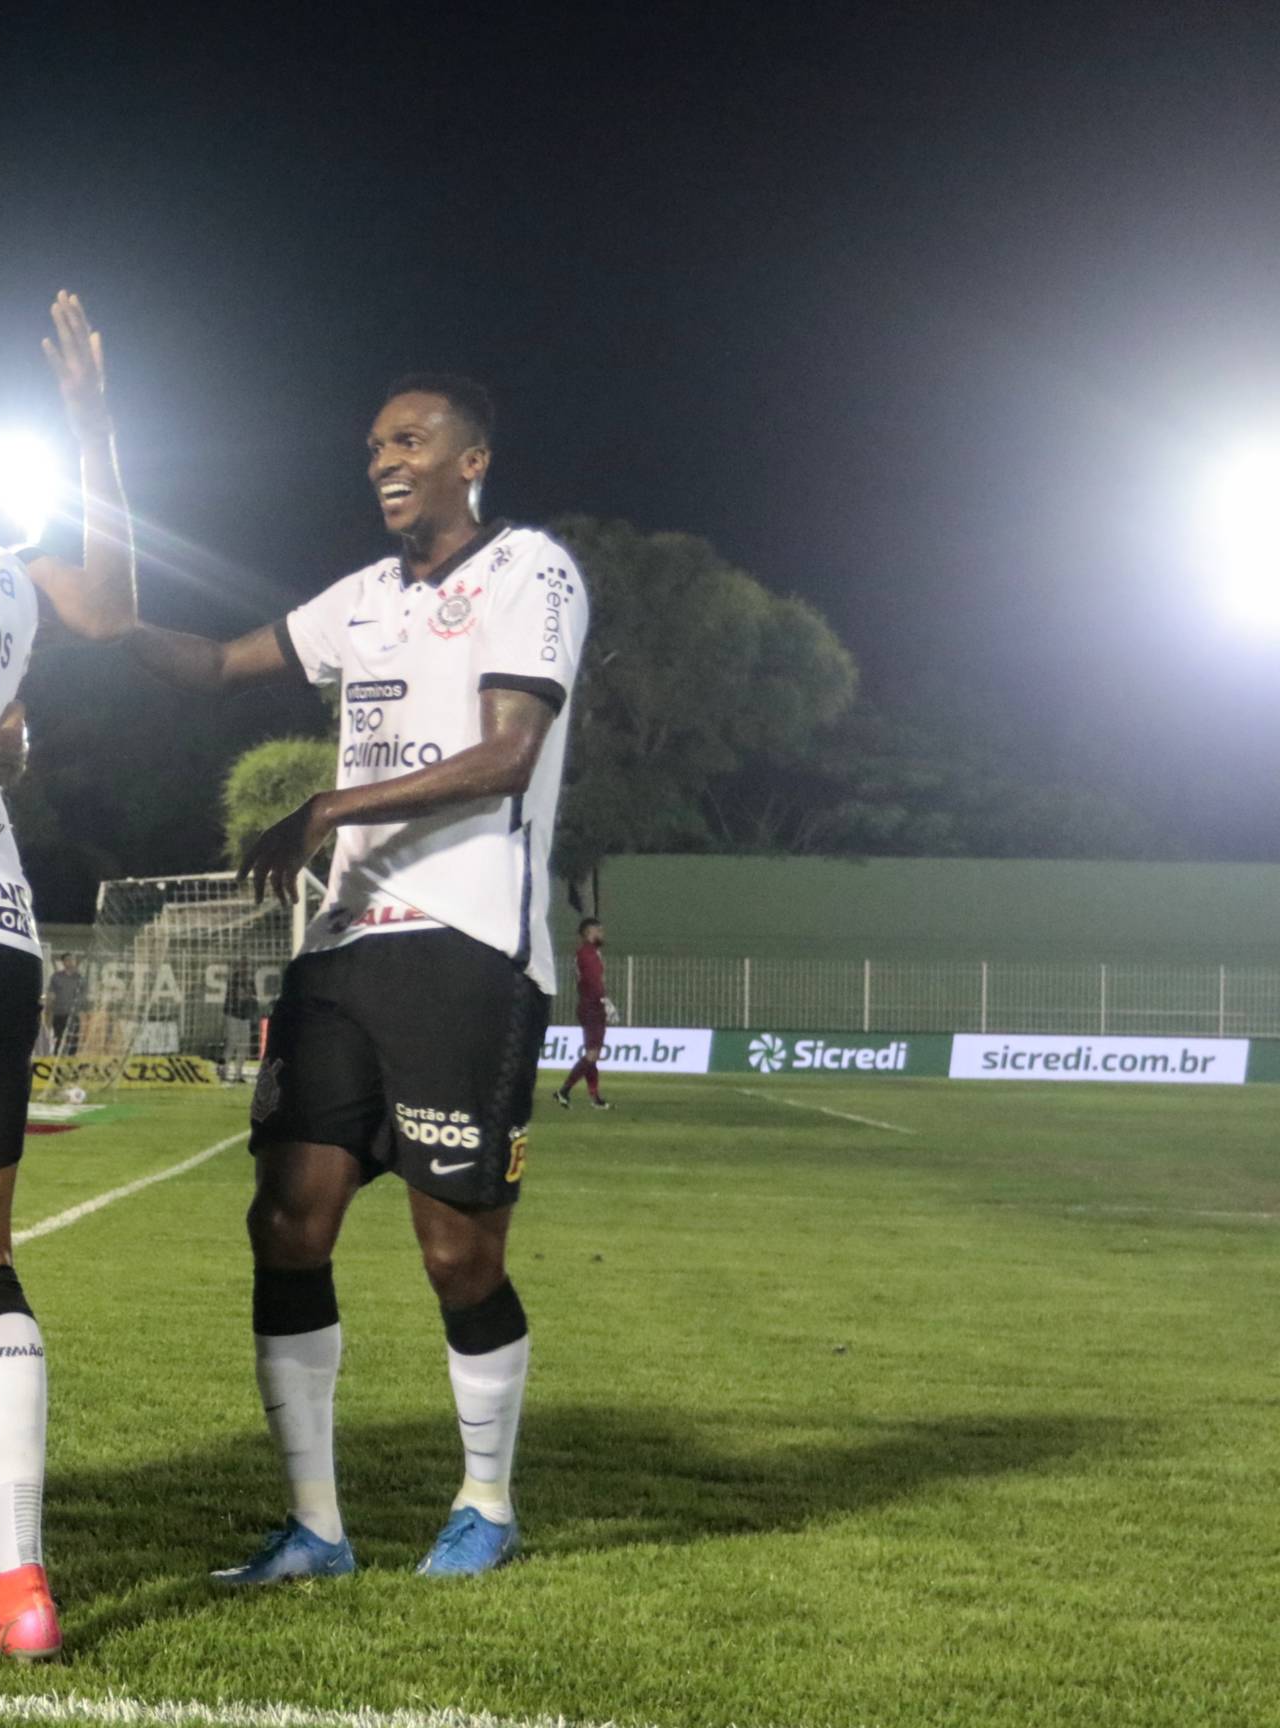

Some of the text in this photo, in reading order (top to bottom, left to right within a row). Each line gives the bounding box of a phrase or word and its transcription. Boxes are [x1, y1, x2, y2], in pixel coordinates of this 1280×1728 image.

[541, 578, 563, 663] serasa
[348, 707, 383, 734] 180
[793, 1040, 907, 1070] Sicredi
[981, 1045, 1216, 1074] sicredi.com.br
[396, 1102, 470, 1124] Cartão de
